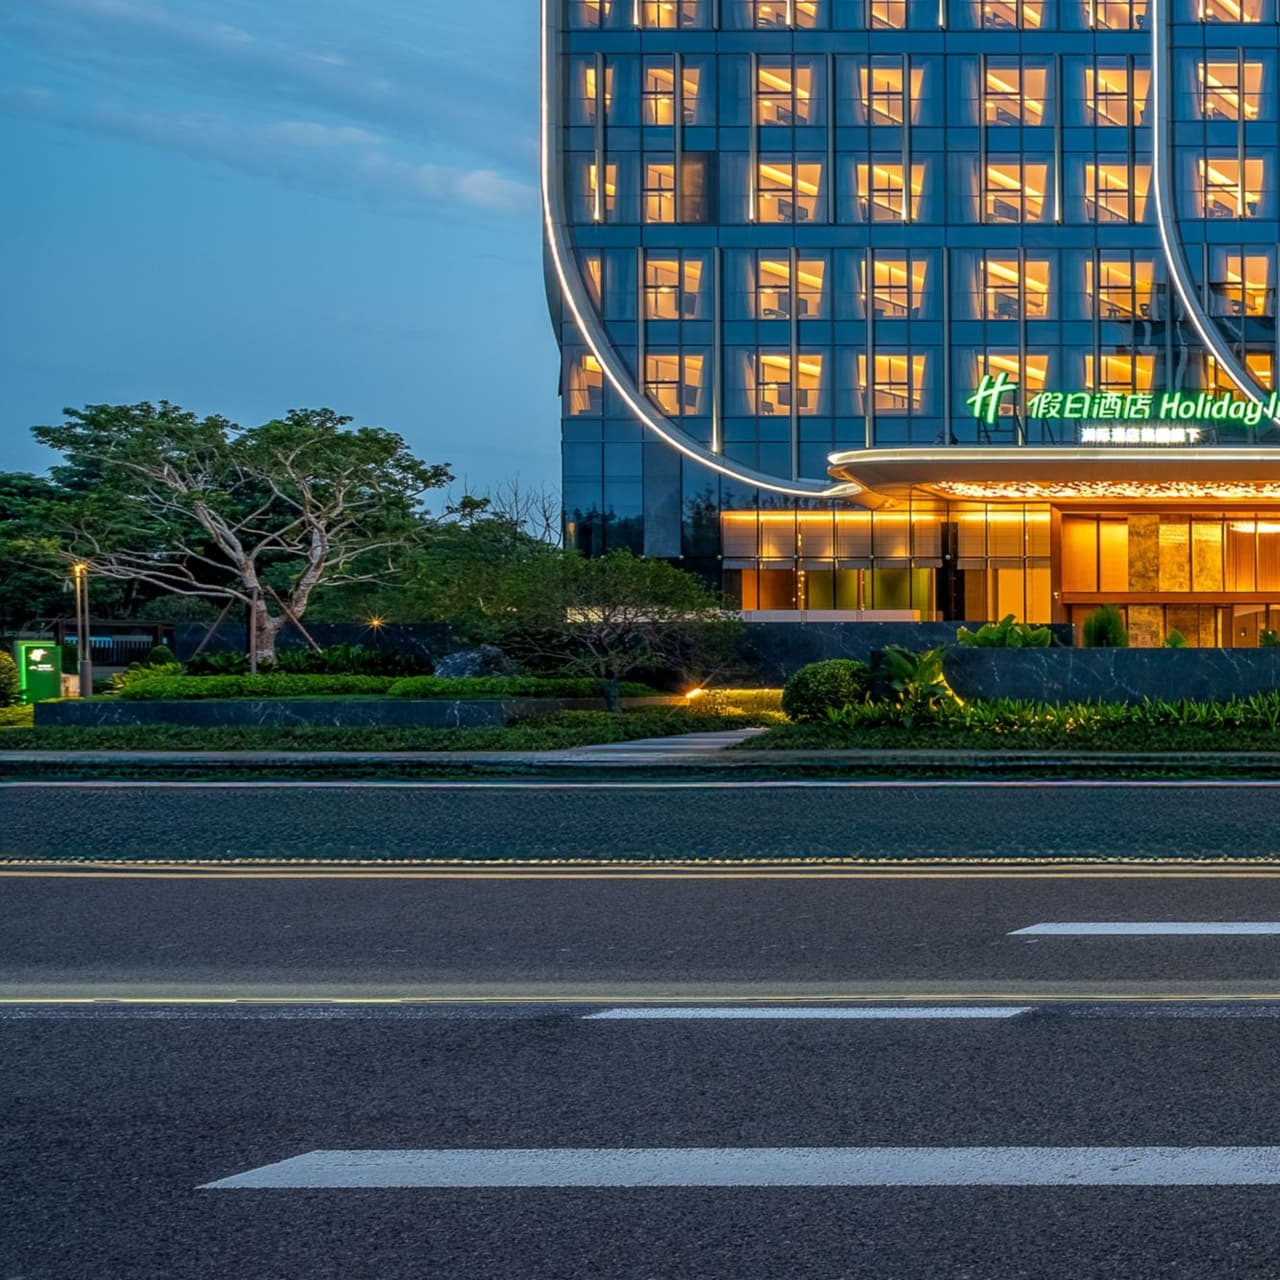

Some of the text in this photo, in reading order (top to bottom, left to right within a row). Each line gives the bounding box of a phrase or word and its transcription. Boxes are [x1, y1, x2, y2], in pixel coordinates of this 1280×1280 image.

[1027, 391, 1153, 420] 假日酒店
[1159, 391, 1264, 425] Holiday
